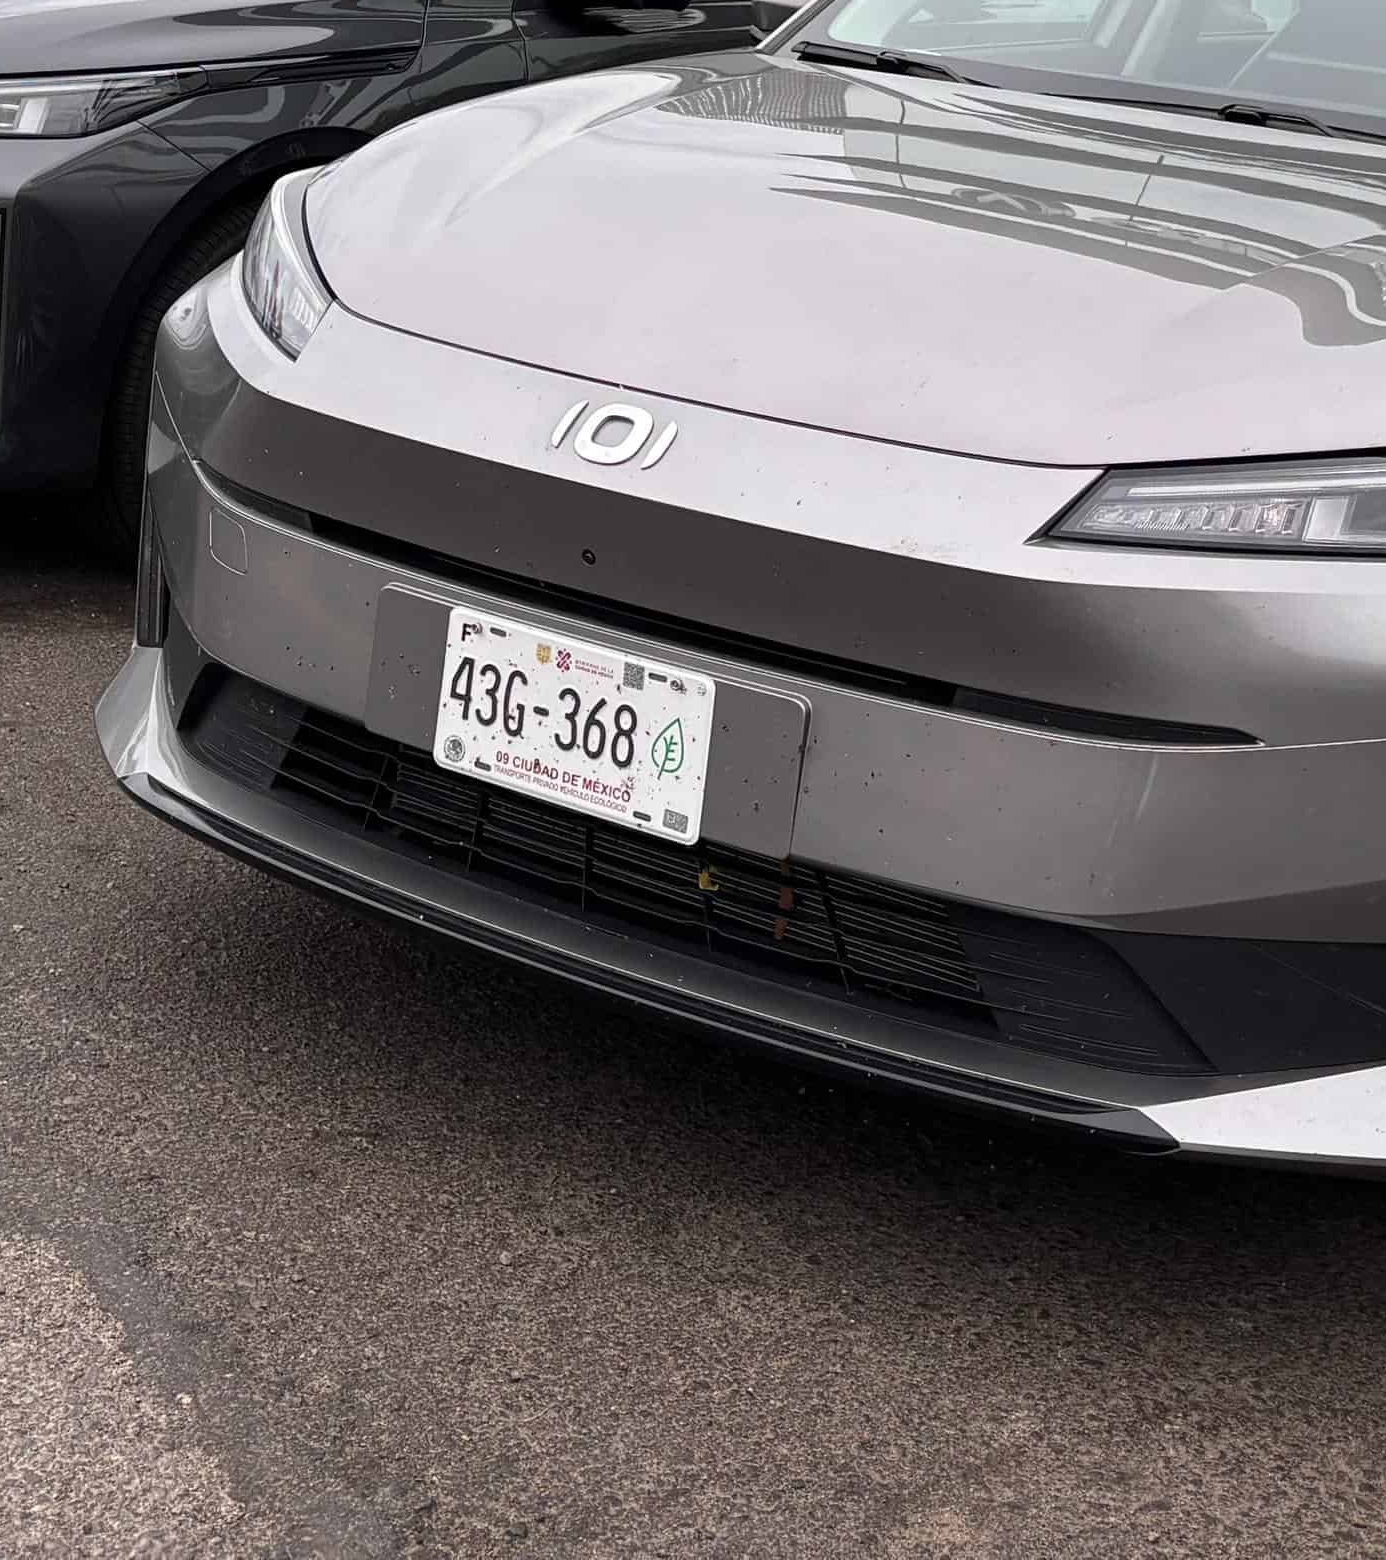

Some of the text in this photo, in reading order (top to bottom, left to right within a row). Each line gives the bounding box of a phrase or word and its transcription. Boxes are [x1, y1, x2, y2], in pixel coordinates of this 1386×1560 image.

[449, 655, 638, 770] 43G-368
[495, 750, 631, 803] 09 CIUDAD DE MÉXICO
